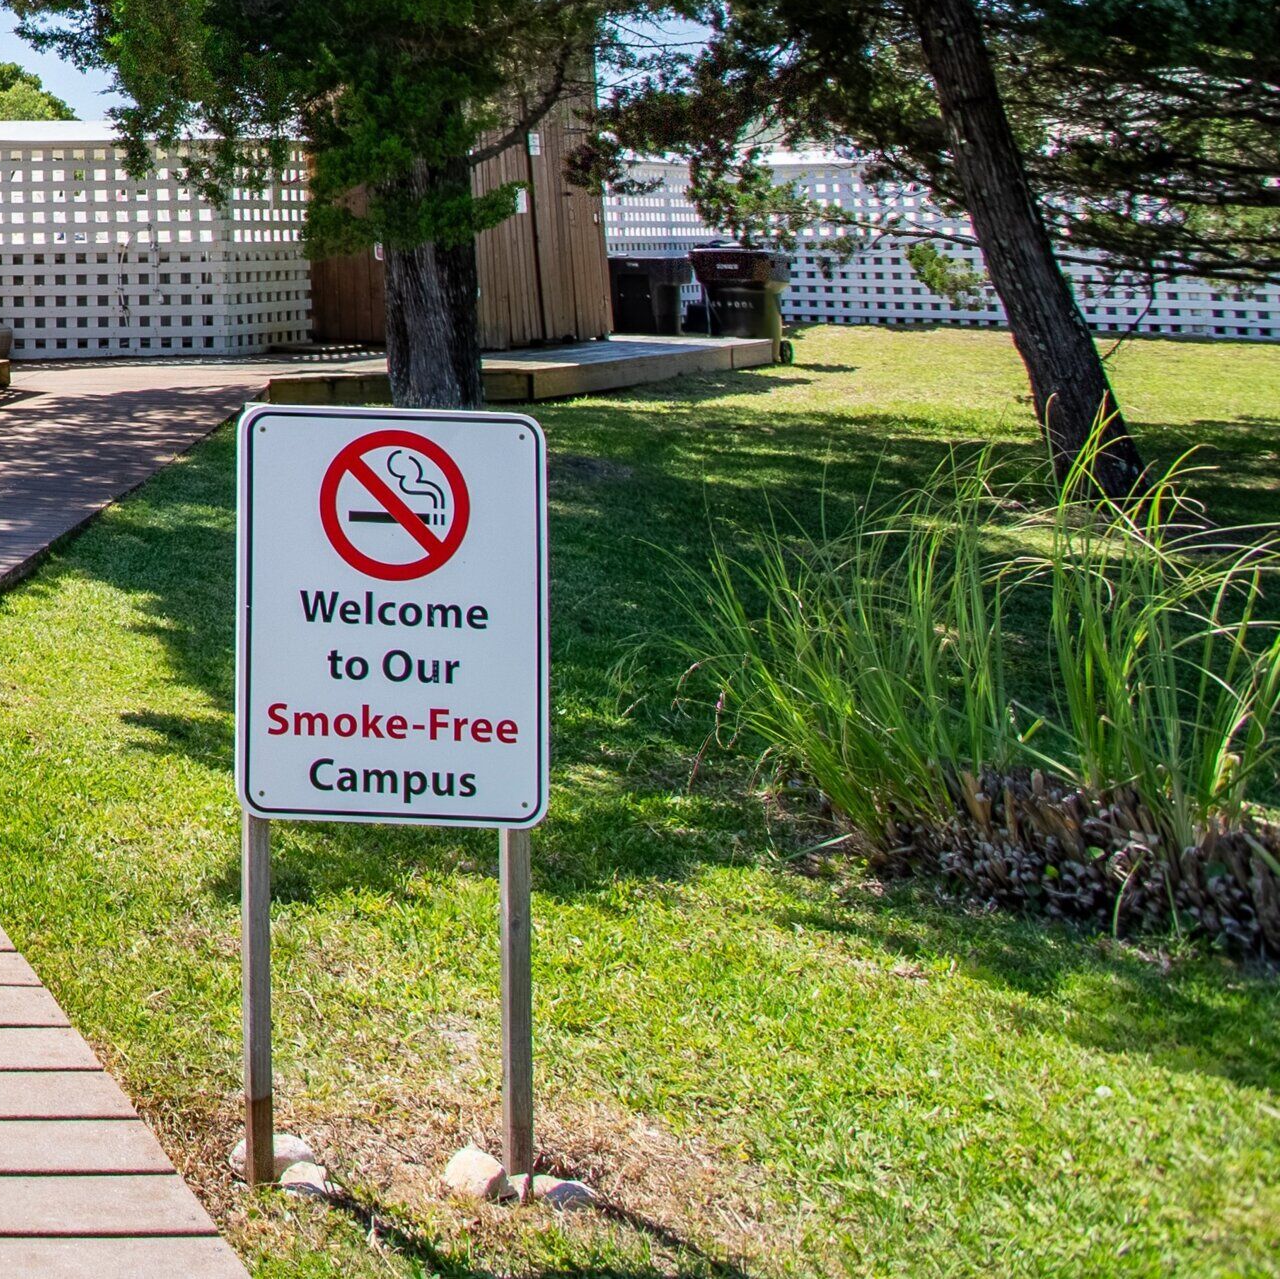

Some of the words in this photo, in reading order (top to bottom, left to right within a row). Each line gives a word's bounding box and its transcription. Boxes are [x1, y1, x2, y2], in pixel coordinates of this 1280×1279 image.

[299, 590, 489, 629] Welcome
[328, 649, 369, 680] to
[382, 649, 460, 684] Our
[267, 703, 519, 744] Smoke-Free
[309, 758, 478, 803] Campus
